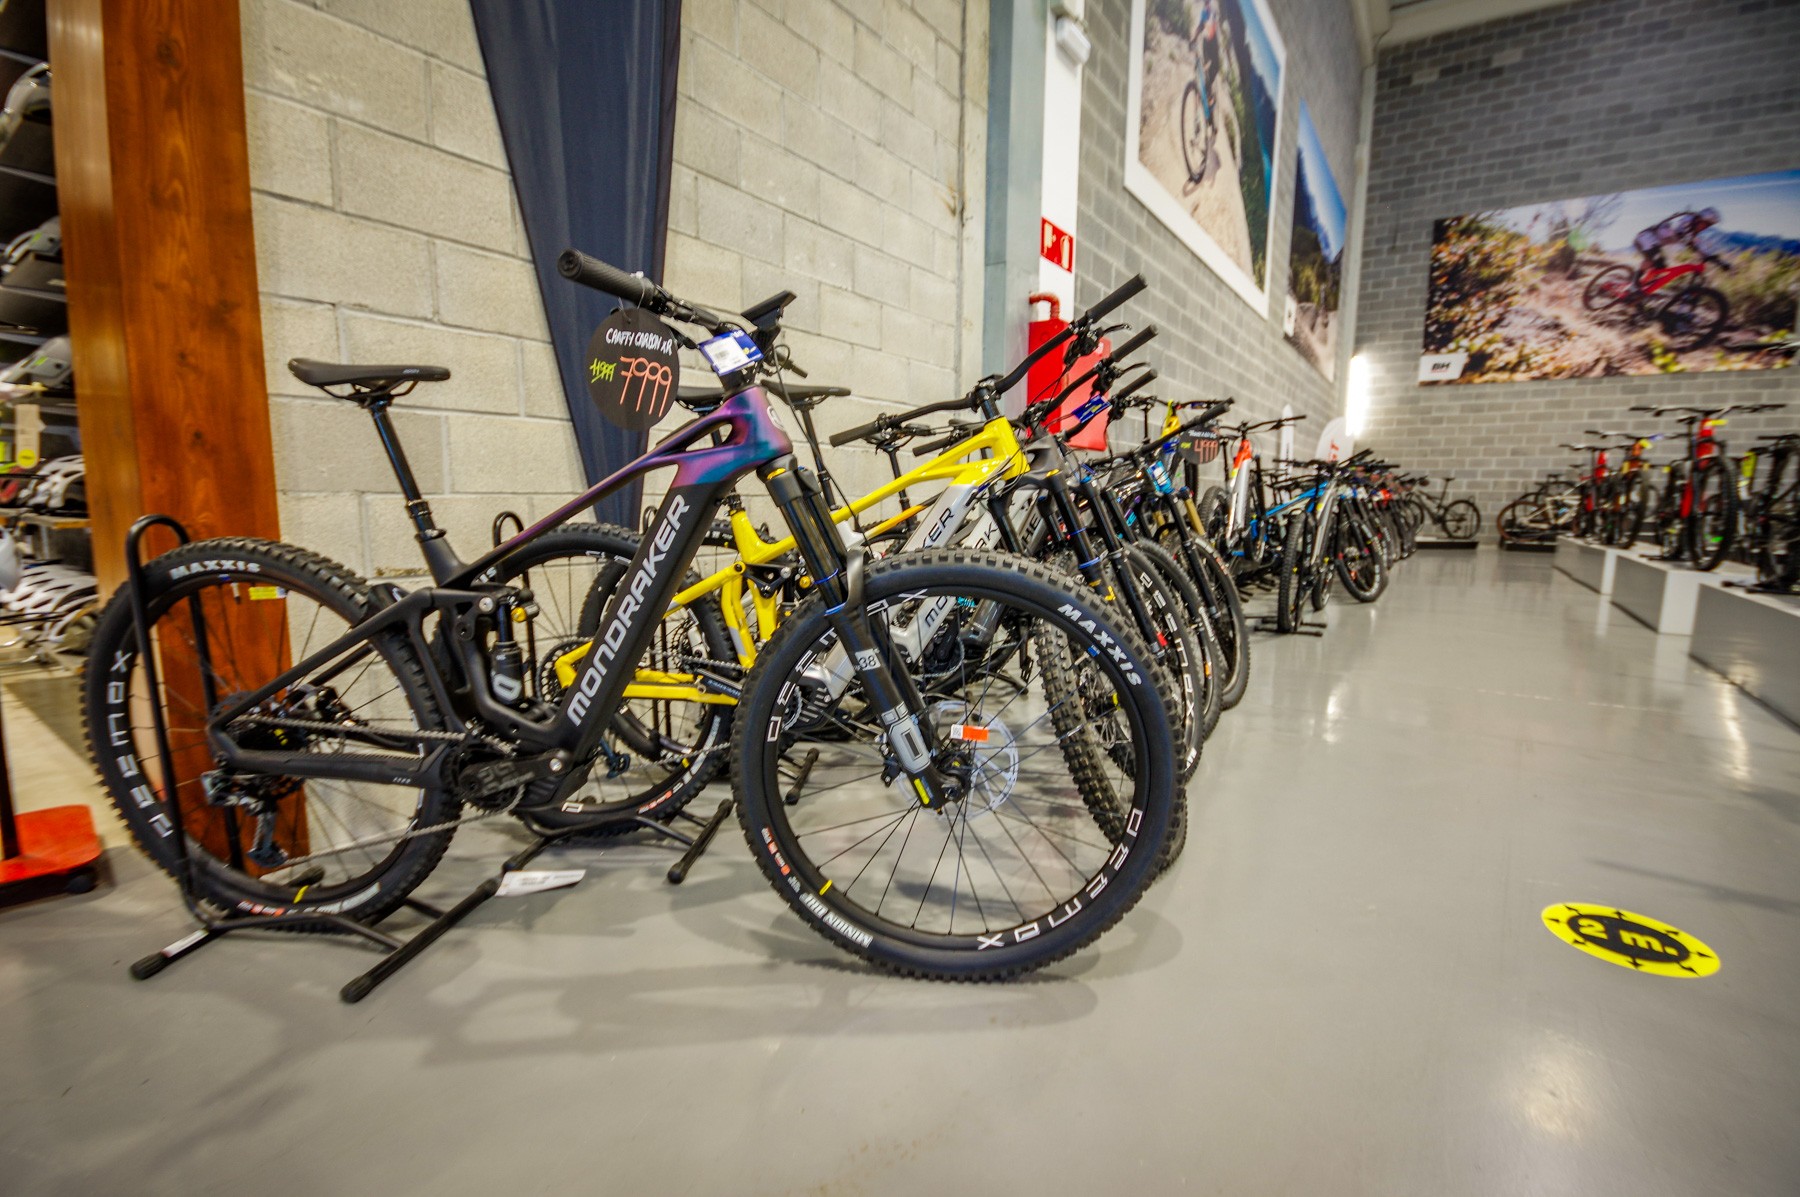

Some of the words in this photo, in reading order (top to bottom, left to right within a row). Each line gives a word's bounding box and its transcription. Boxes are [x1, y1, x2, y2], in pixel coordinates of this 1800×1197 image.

[634, 331, 662, 350] CARBON
[619, 356, 673, 417] 7999
[169, 560, 261, 580] MAXXIS
[567, 494, 690, 727] MONDRAKER
[1057, 603, 1142, 686] MAXXIS
[859, 654, 877, 669] 38
[822, 911, 874, 949] MINION
[1577, 917, 1609, 939] 2
